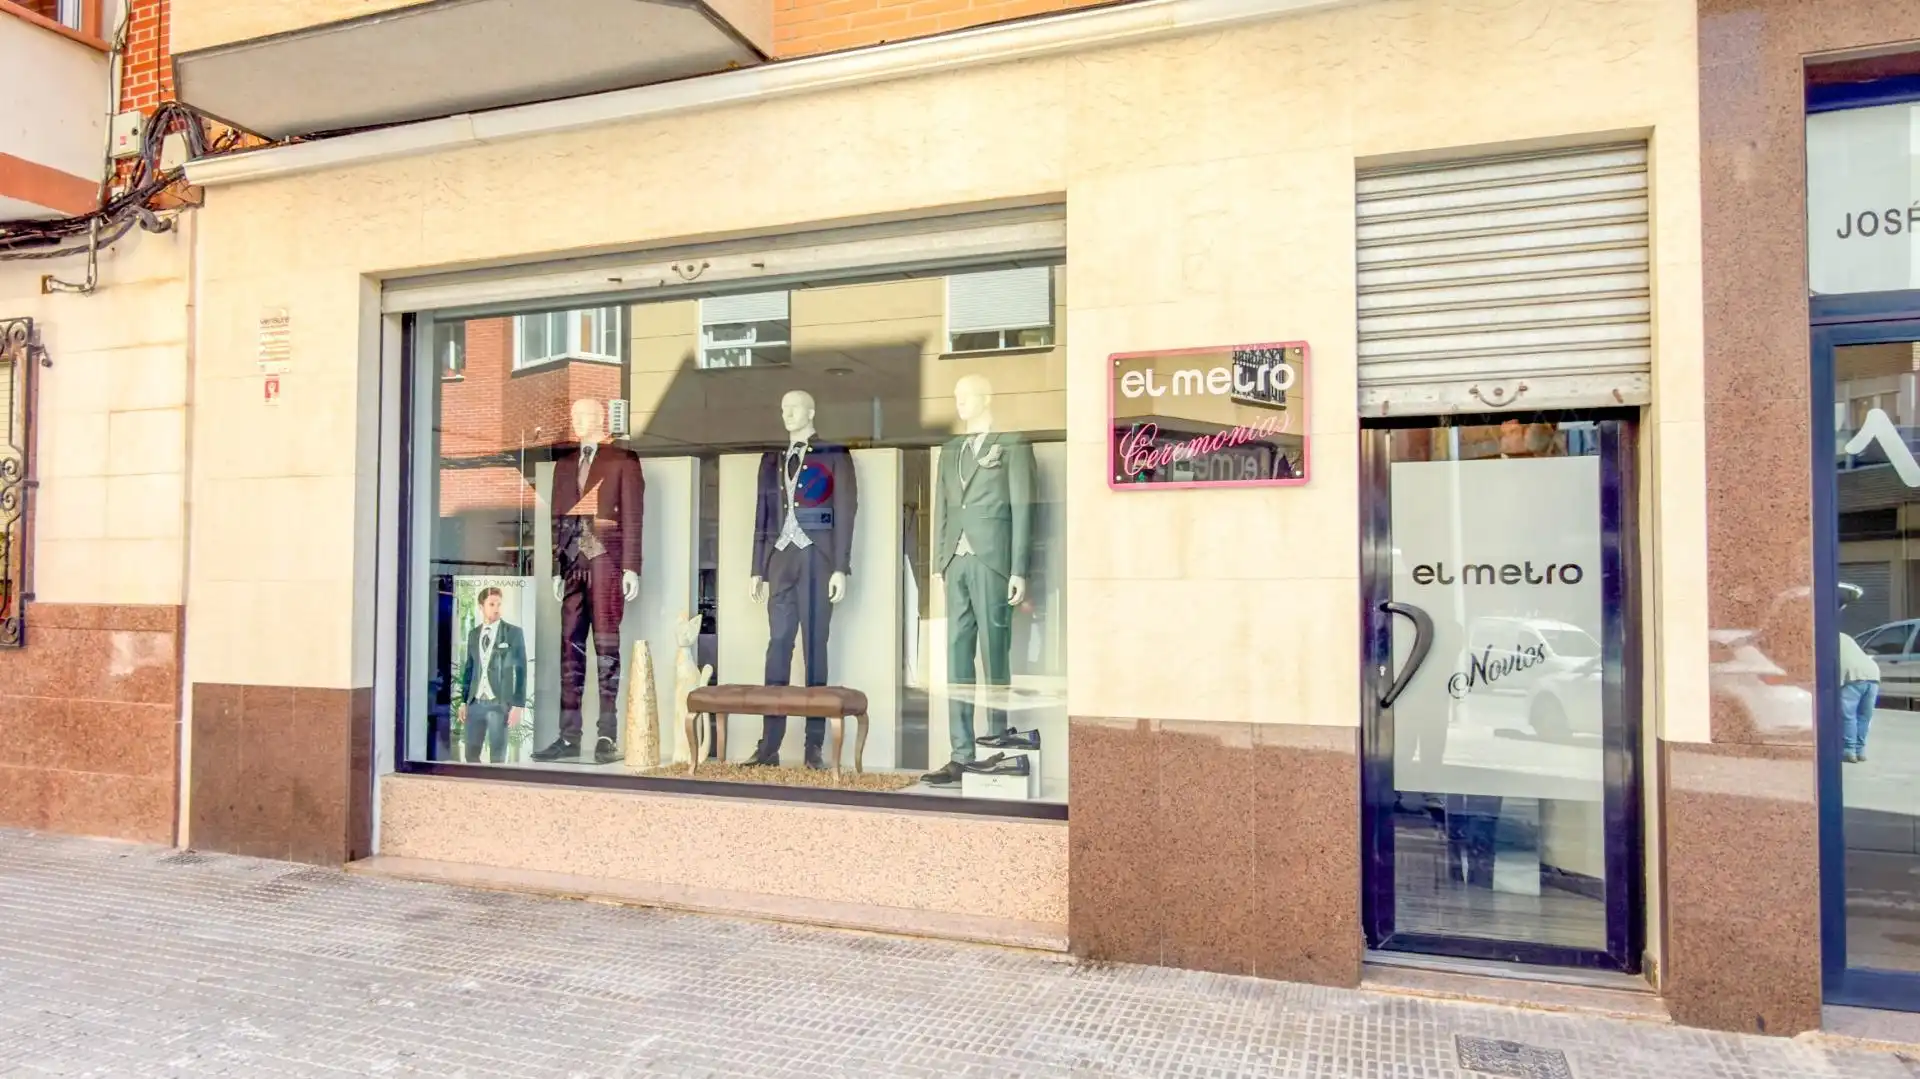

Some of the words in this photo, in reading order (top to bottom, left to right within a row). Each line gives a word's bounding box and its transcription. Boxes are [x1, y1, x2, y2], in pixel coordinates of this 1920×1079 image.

[1121, 368, 1167, 398] el
[1172, 363, 1295, 396] metro
[1119, 411, 1294, 476] Ceremonias
[484, 579, 526, 588] ROMANO
[1412, 561, 1455, 586] el
[1462, 560, 1583, 586] metro
[1447, 643, 1546, 699] Novios
